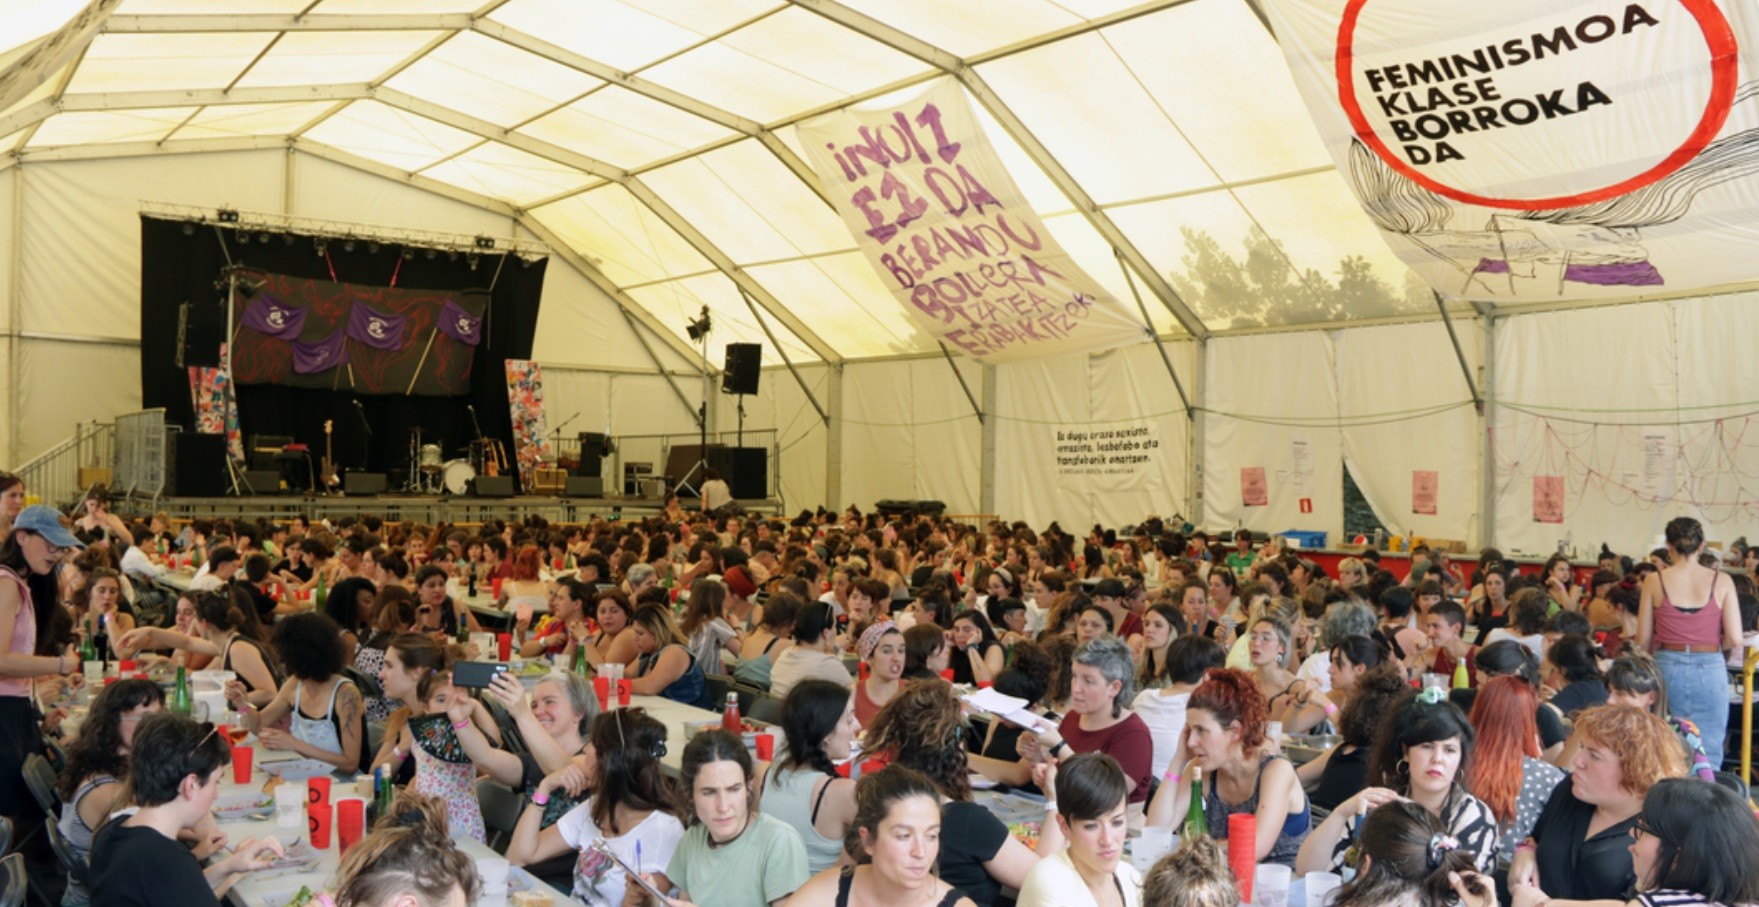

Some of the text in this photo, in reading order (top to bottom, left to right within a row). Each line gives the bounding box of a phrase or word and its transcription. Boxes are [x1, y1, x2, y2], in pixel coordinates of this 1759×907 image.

[1365, 3, 1659, 93] FEMINISMOA
[1376, 77, 1501, 117] KLASE
[1389, 81, 1613, 142] BORROKA
[1403, 142, 1465, 165] DA
[923, 164, 1005, 217] DA
[881, 213, 1042, 289] BERANDU
[951, 289, 1057, 330] IZATEA
[1067, 430, 1088, 443] dugu
[1090, 431, 1114, 440] eraso
